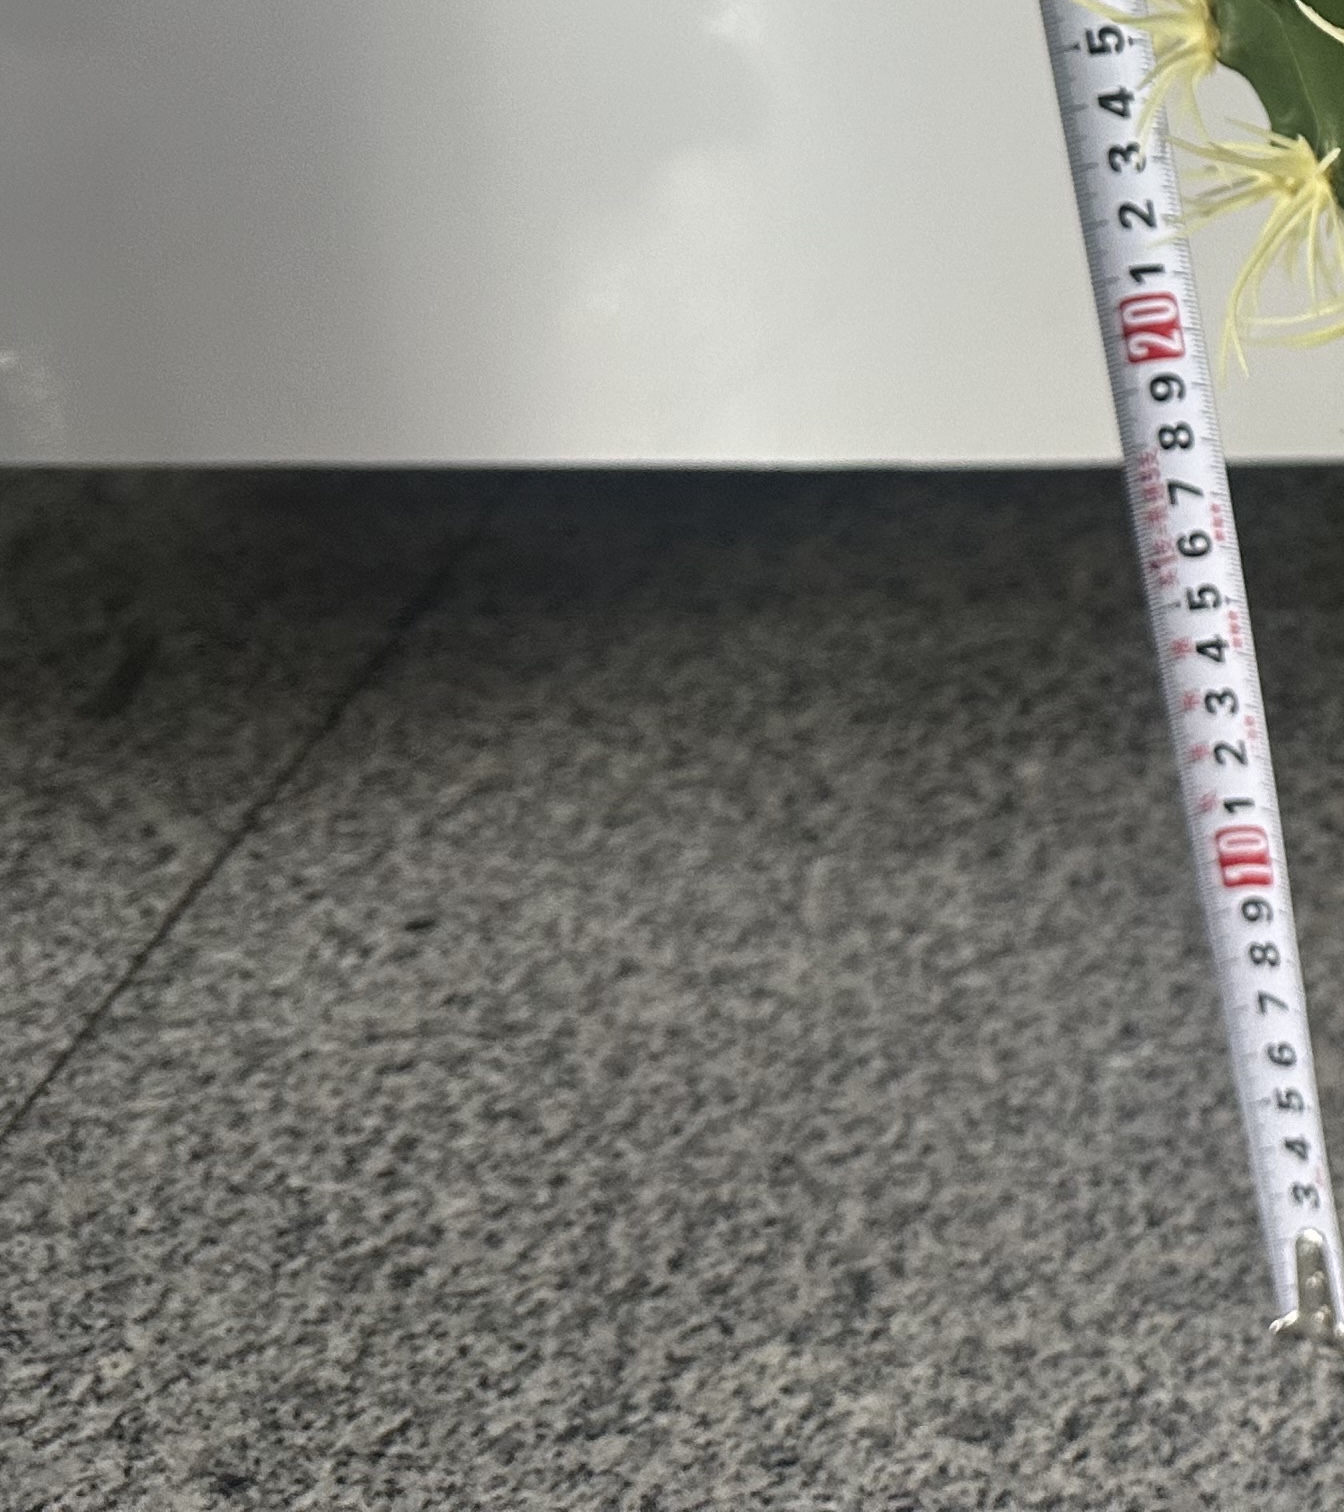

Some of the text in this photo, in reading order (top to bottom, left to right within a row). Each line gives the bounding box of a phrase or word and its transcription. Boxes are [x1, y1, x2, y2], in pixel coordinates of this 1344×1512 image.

[1086, 24, 1125, 55] 5
[1097, 86, 1135, 118] 4
[1108, 141, 1146, 173] 3
[1117, 199, 1157, 229] 2
[1128, 263, 1165, 285] 1
[1122, 298, 1184, 358] 20
[1150, 374, 1186, 402] 9
[1157, 421, 1194, 450] 8
[1167, 478, 1204, 506] 7
[1176, 529, 1213, 558] 6
[1186, 583, 1222, 611] 5
[1196, 634, 1229, 663] 4
[1204, 687, 1239, 715] 3
[1213, 739, 1248, 766] 2
[1223, 797, 1255, 814] 1
[1218, 829, 1272, 881] 10
[1241, 896, 1273, 924] 9
[1249, 942, 1280, 968] 8
[1258, 991, 1290, 1016] 7
[1267, 1041, 1297, 1067] 6
[1276, 1090, 1304, 1114] 5
[1285, 1134, 1311, 1160] 4
[1293, 1183, 1320, 1209] 3
